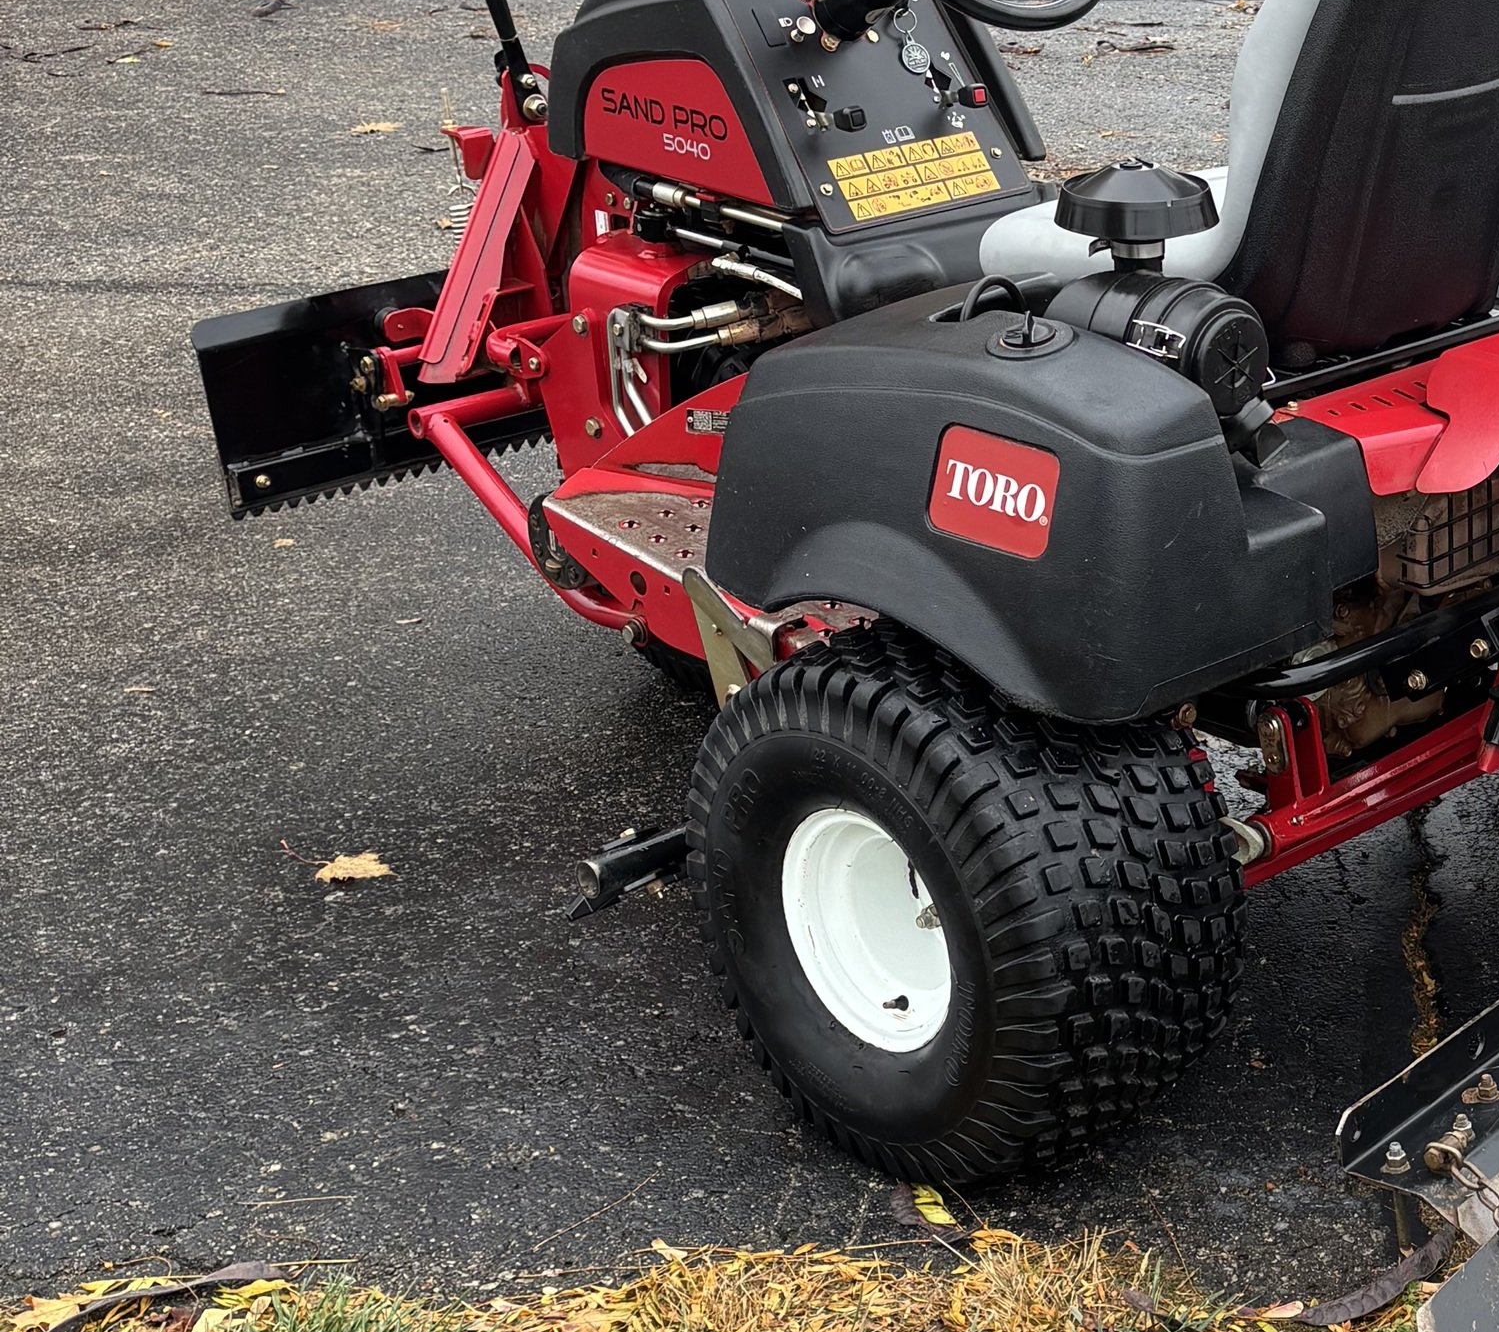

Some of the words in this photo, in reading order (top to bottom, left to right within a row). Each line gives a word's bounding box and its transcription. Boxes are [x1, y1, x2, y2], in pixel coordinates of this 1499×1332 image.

[601, 87, 666, 126] SAND
[672, 103, 729, 142] PRO
[662, 132, 712, 161] 5040
[945, 458, 1047, 524] TORO
